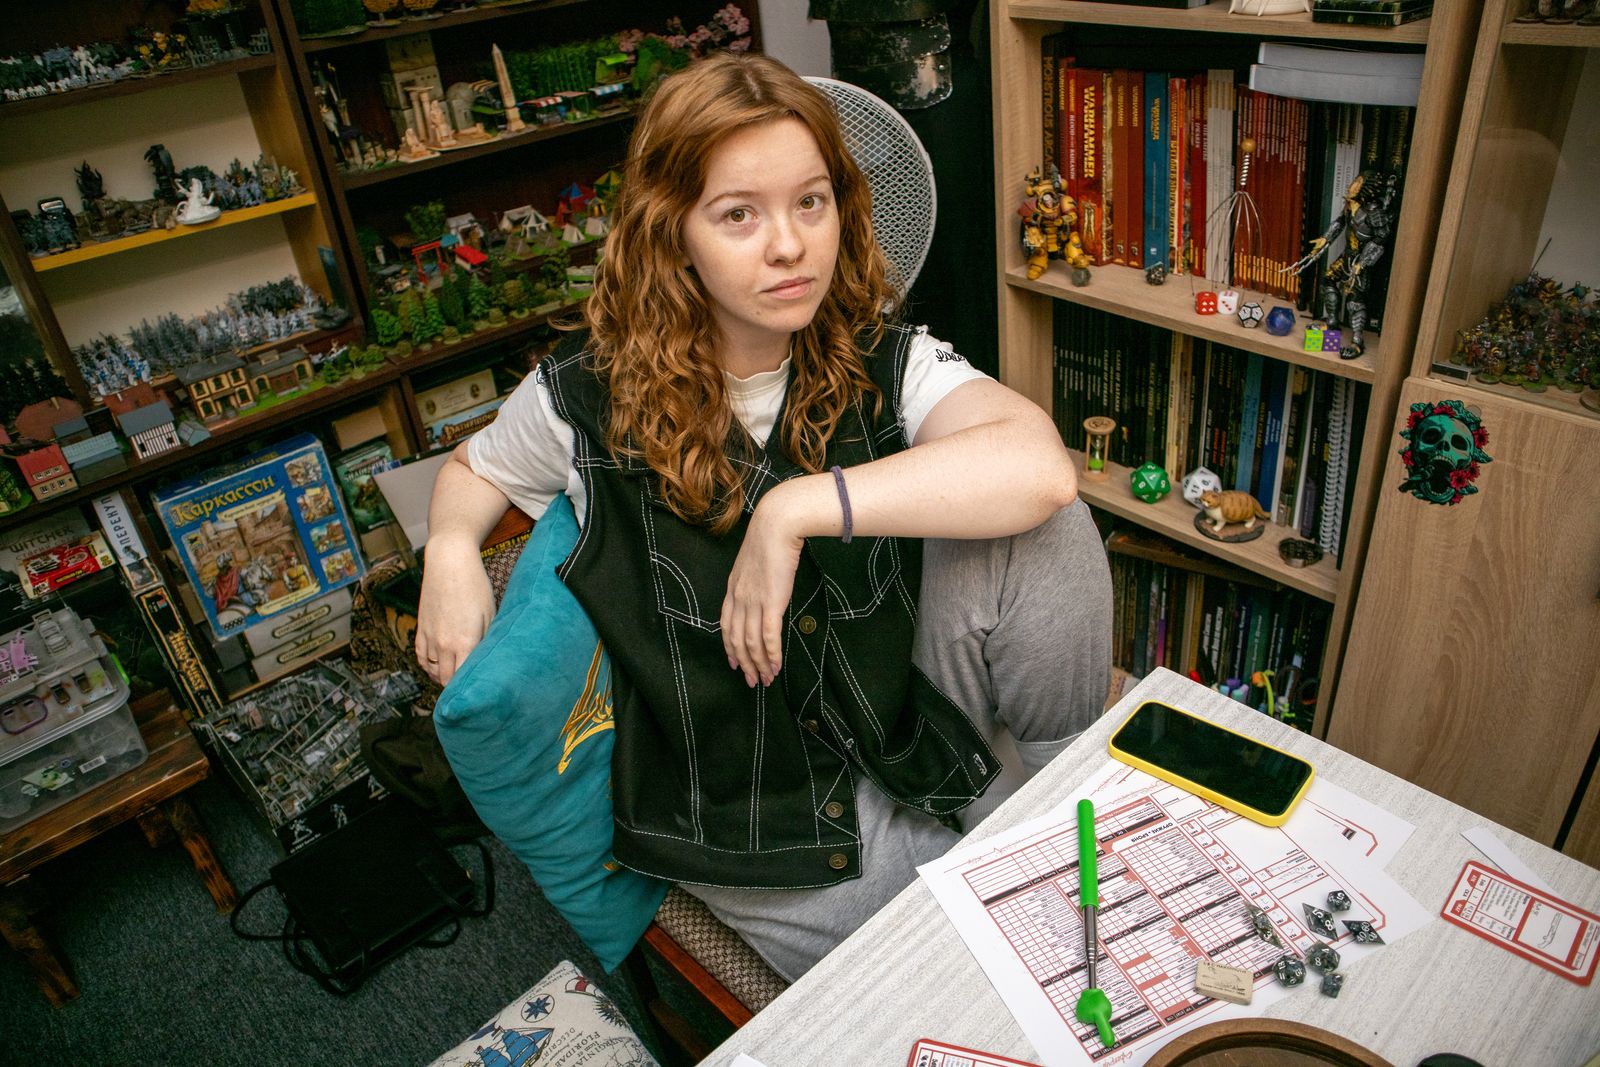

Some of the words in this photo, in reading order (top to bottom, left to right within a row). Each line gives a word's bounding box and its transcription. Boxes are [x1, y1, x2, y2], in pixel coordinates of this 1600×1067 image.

[1043, 57, 1053, 128] MONSTROUS
[1082, 86, 1096, 178] WARHAMMER
[170, 472, 278, 526] Каркассон
[100, 495, 130, 546] ПЕРЕКУП
[8, 524, 73, 554] WITCHER
[1131, 832, 1149, 843] БРОНЯ
[1151, 822, 1173, 834] ОРУЖИЕ
[1312, 909, 1324, 920] 5
[1324, 920, 1334, 931] 8
